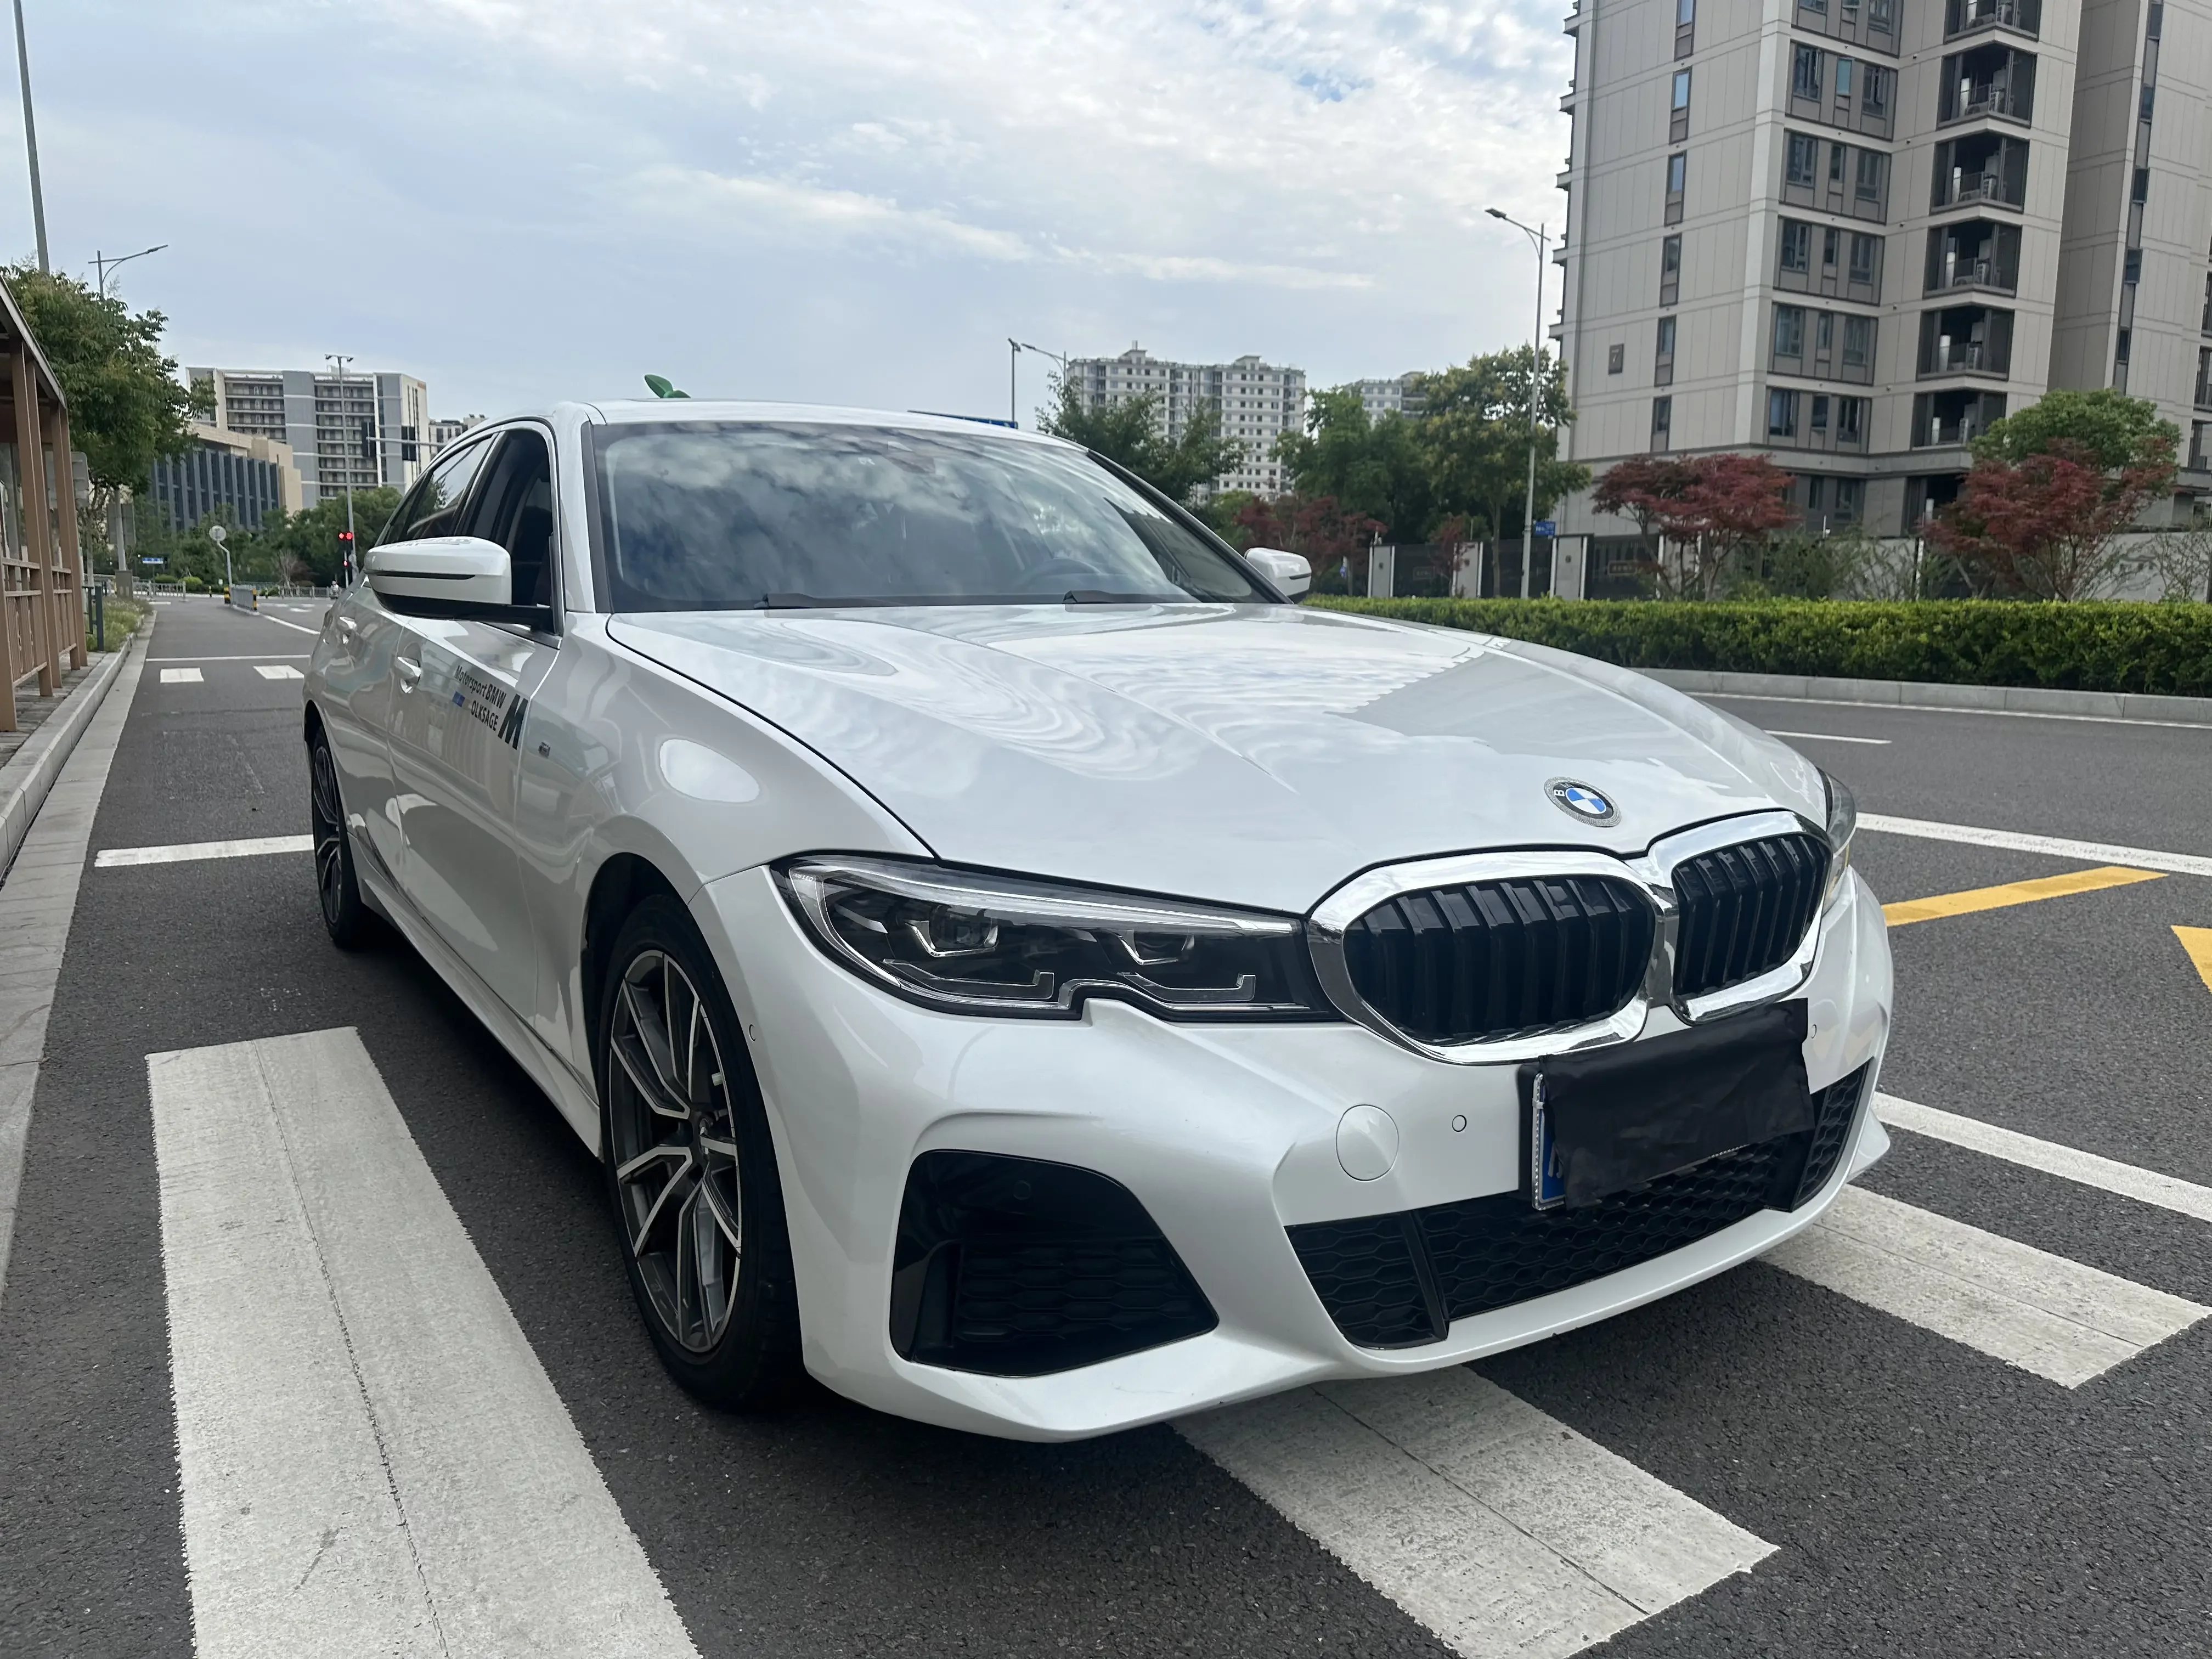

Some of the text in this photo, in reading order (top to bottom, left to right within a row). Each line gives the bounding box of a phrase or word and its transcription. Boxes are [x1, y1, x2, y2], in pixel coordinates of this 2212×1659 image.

[454, 665, 507, 709] Motorsport BMW
[471, 699, 499, 732] OLKSAGE
[498, 693, 528, 751] M
